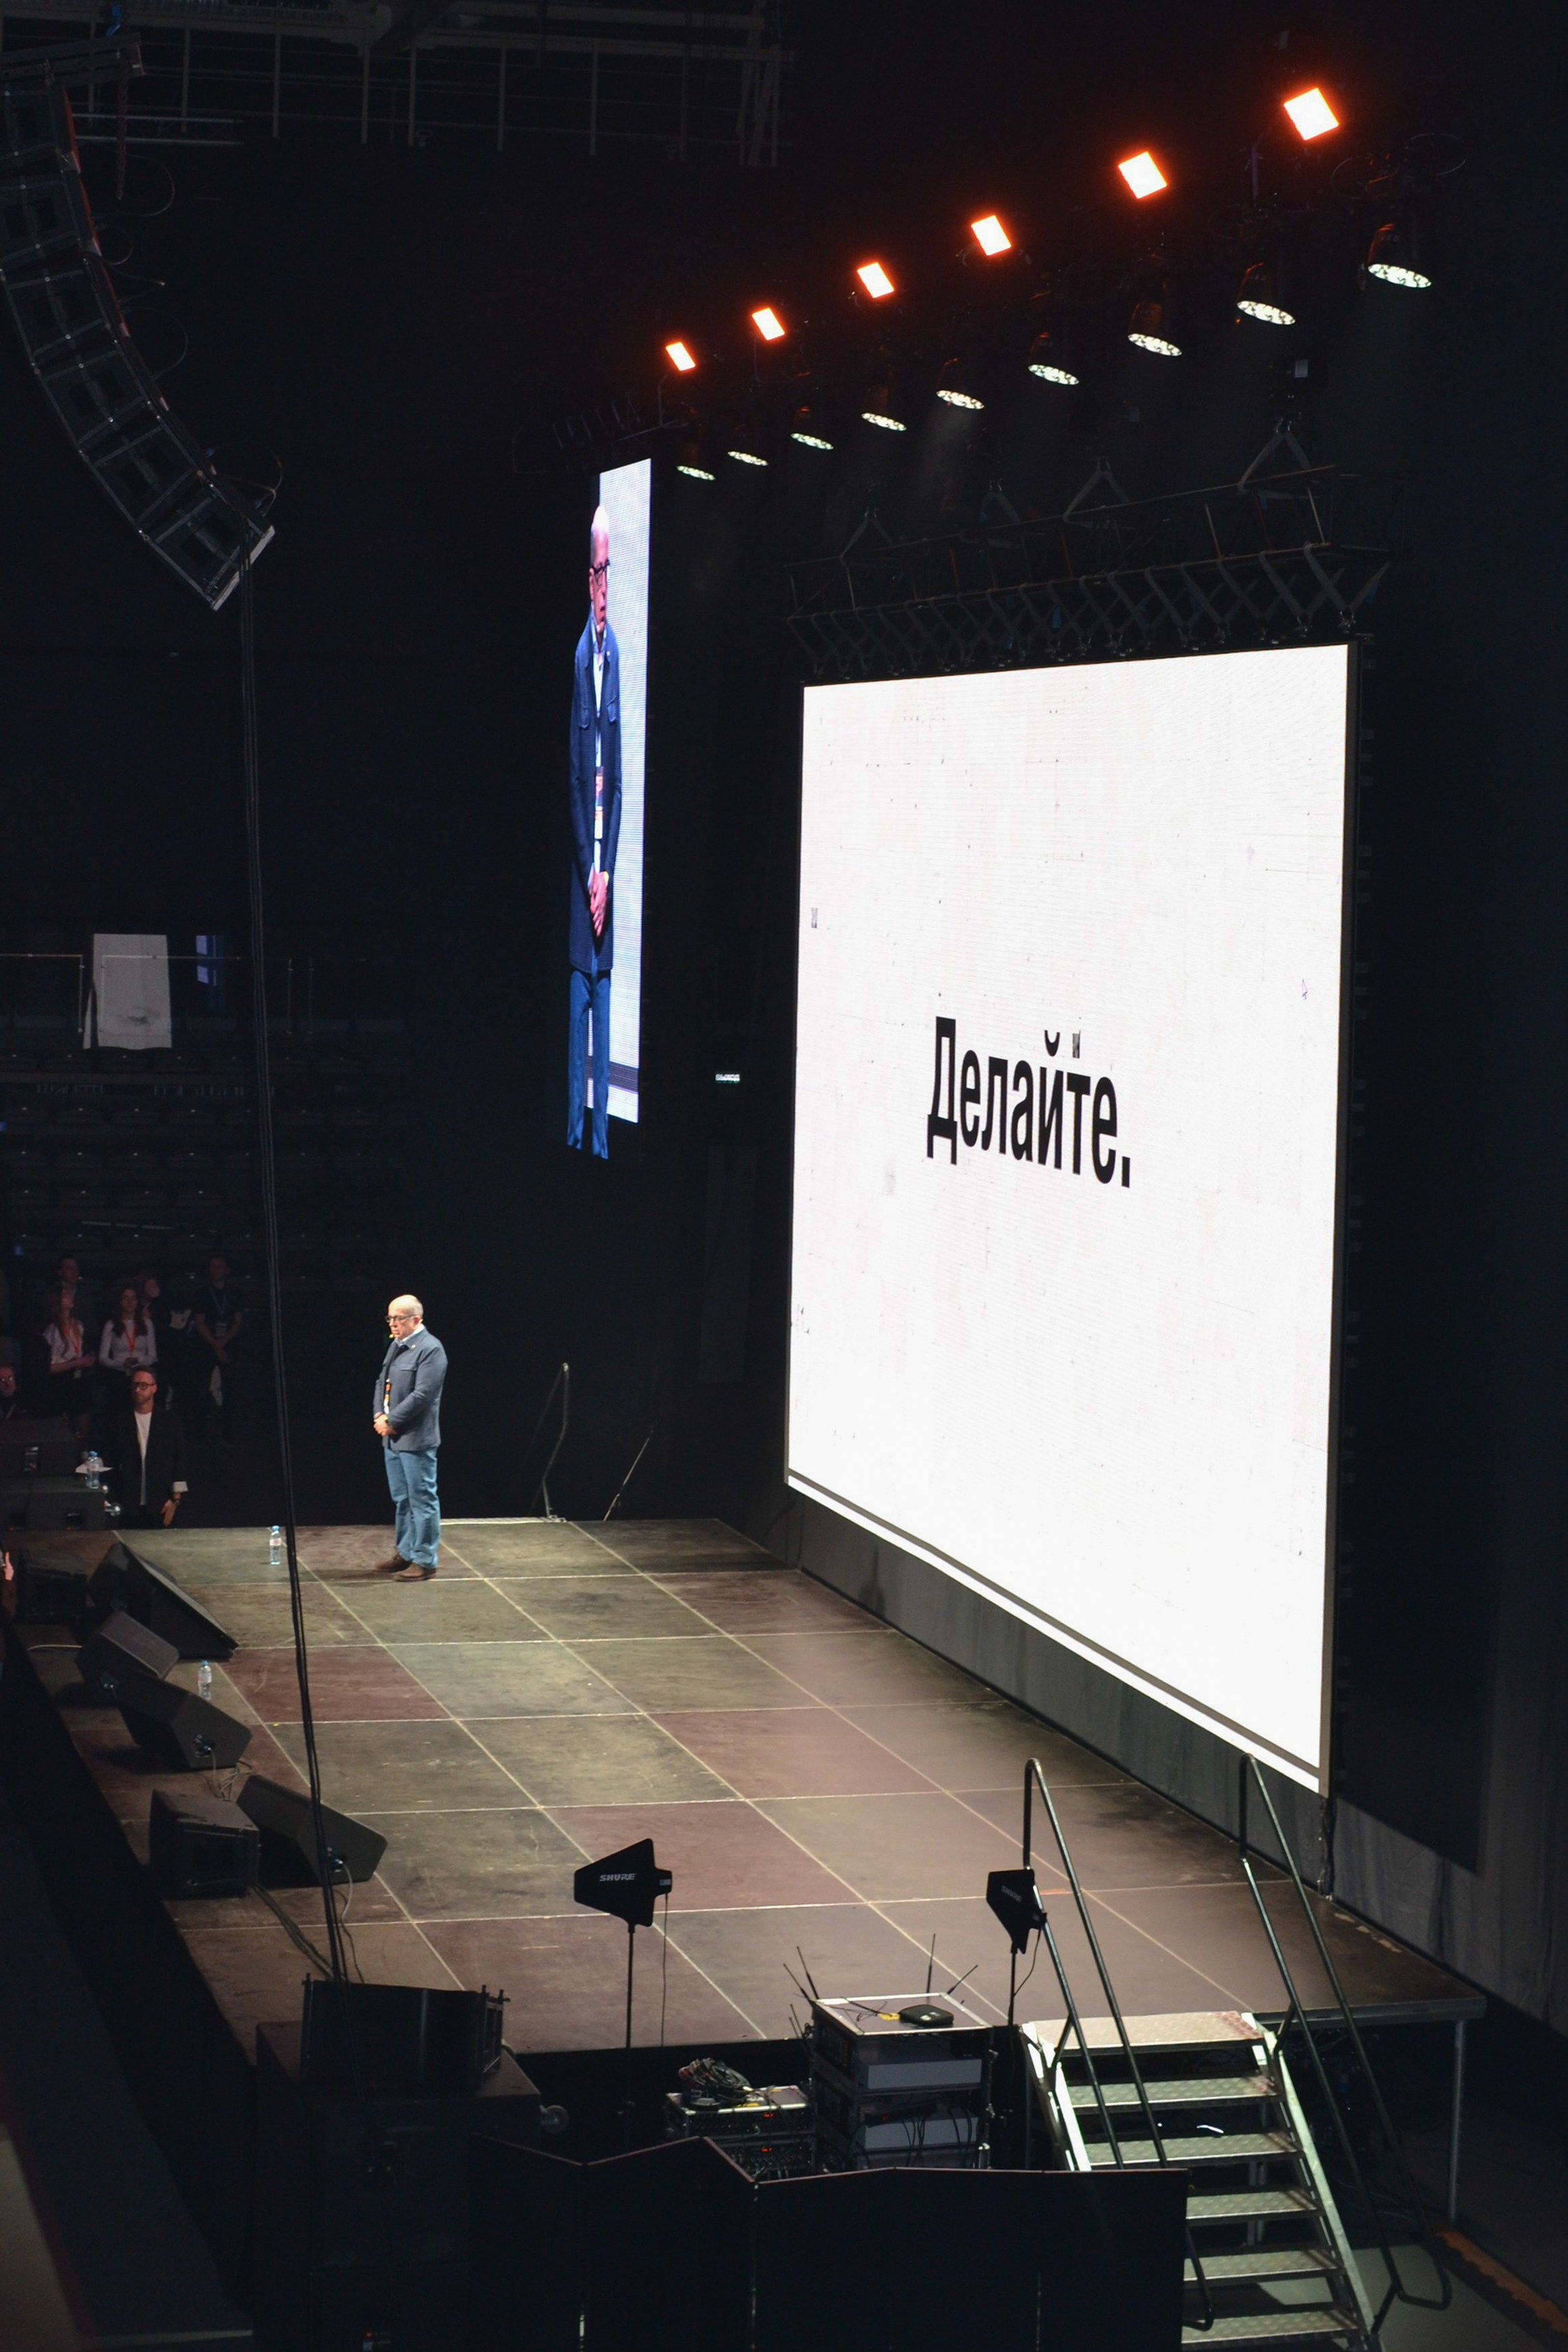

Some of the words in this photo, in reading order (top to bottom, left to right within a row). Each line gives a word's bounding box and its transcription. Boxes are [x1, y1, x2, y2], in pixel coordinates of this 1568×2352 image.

[927, 1016, 1131, 1188] Делайте.
[599, 1873, 636, 1882] SHURE
[1001, 1885, 1023, 1903] SHURE
